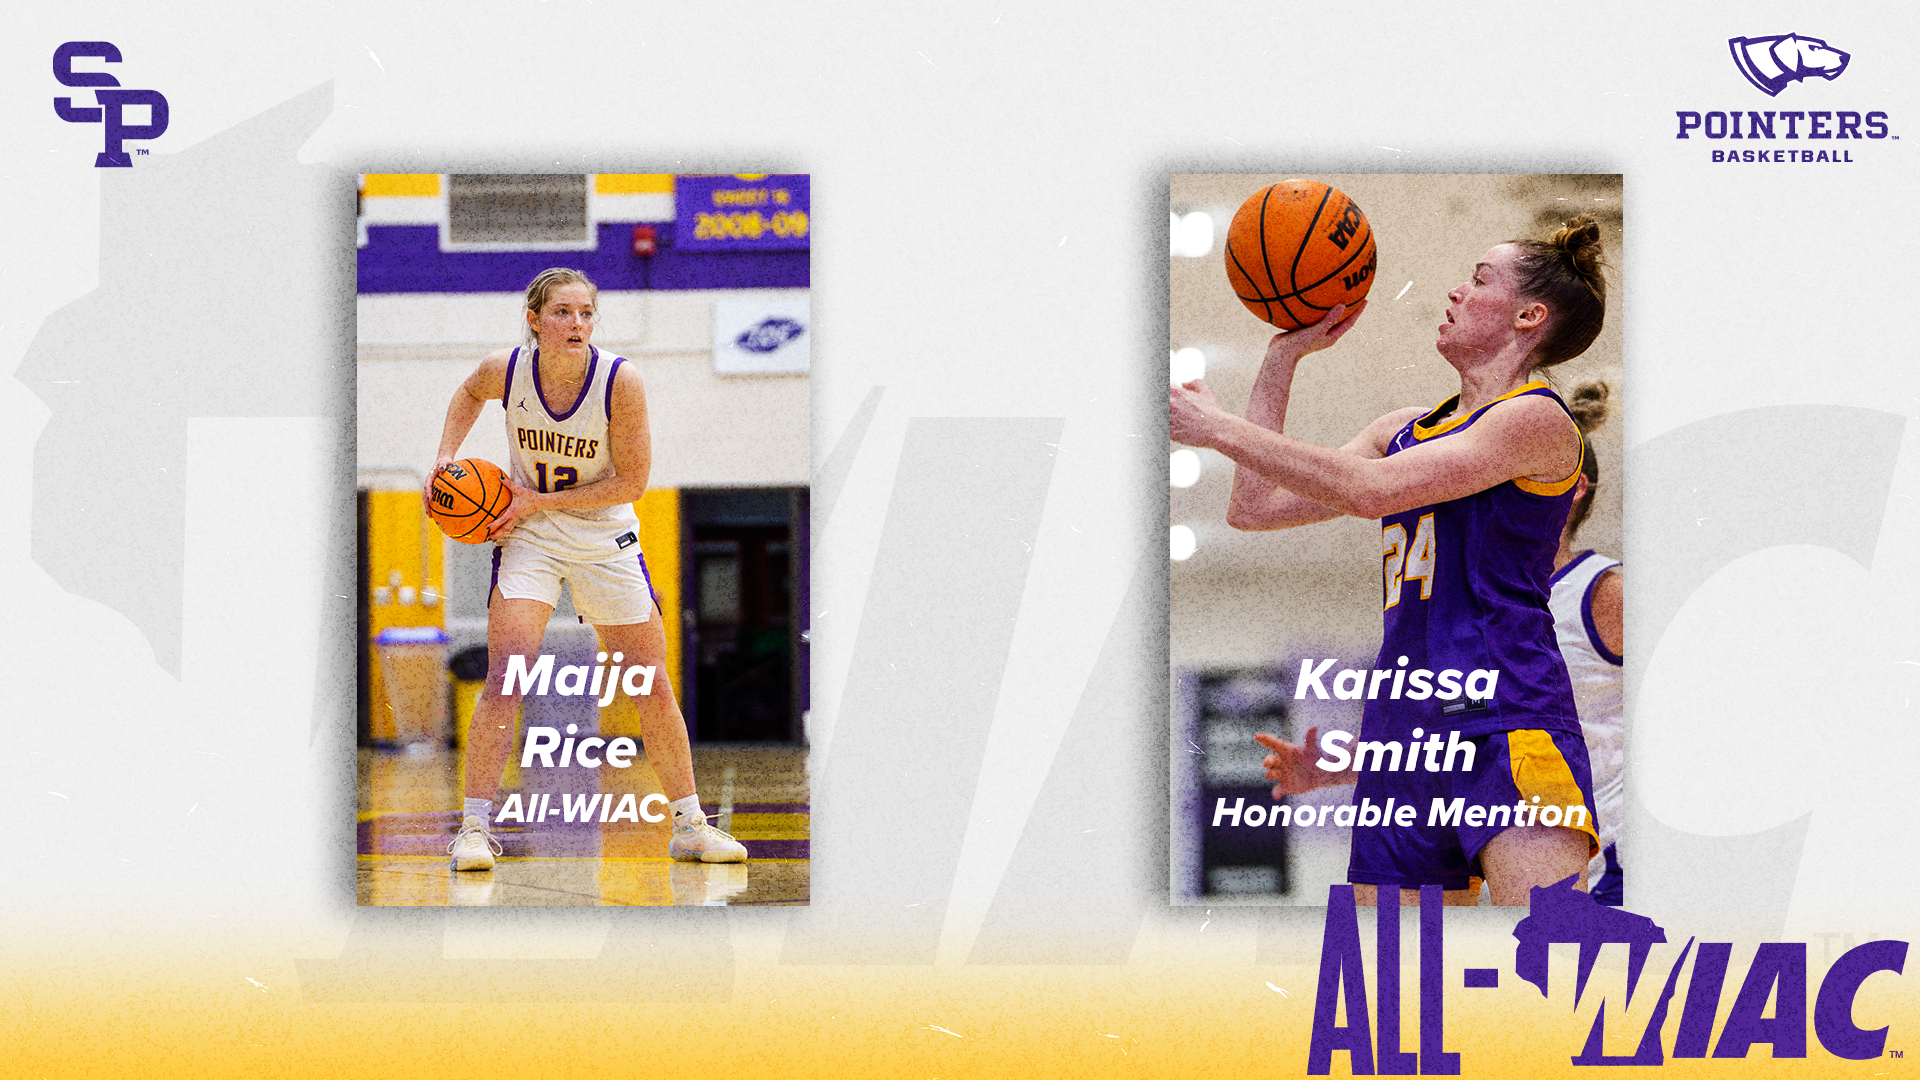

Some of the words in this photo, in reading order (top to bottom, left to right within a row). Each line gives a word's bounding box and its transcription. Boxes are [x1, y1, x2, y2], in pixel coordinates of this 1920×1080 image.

[517, 427, 599, 459] POINTERS
[534, 460, 580, 494] 12
[1382, 512, 1436, 611] 24
